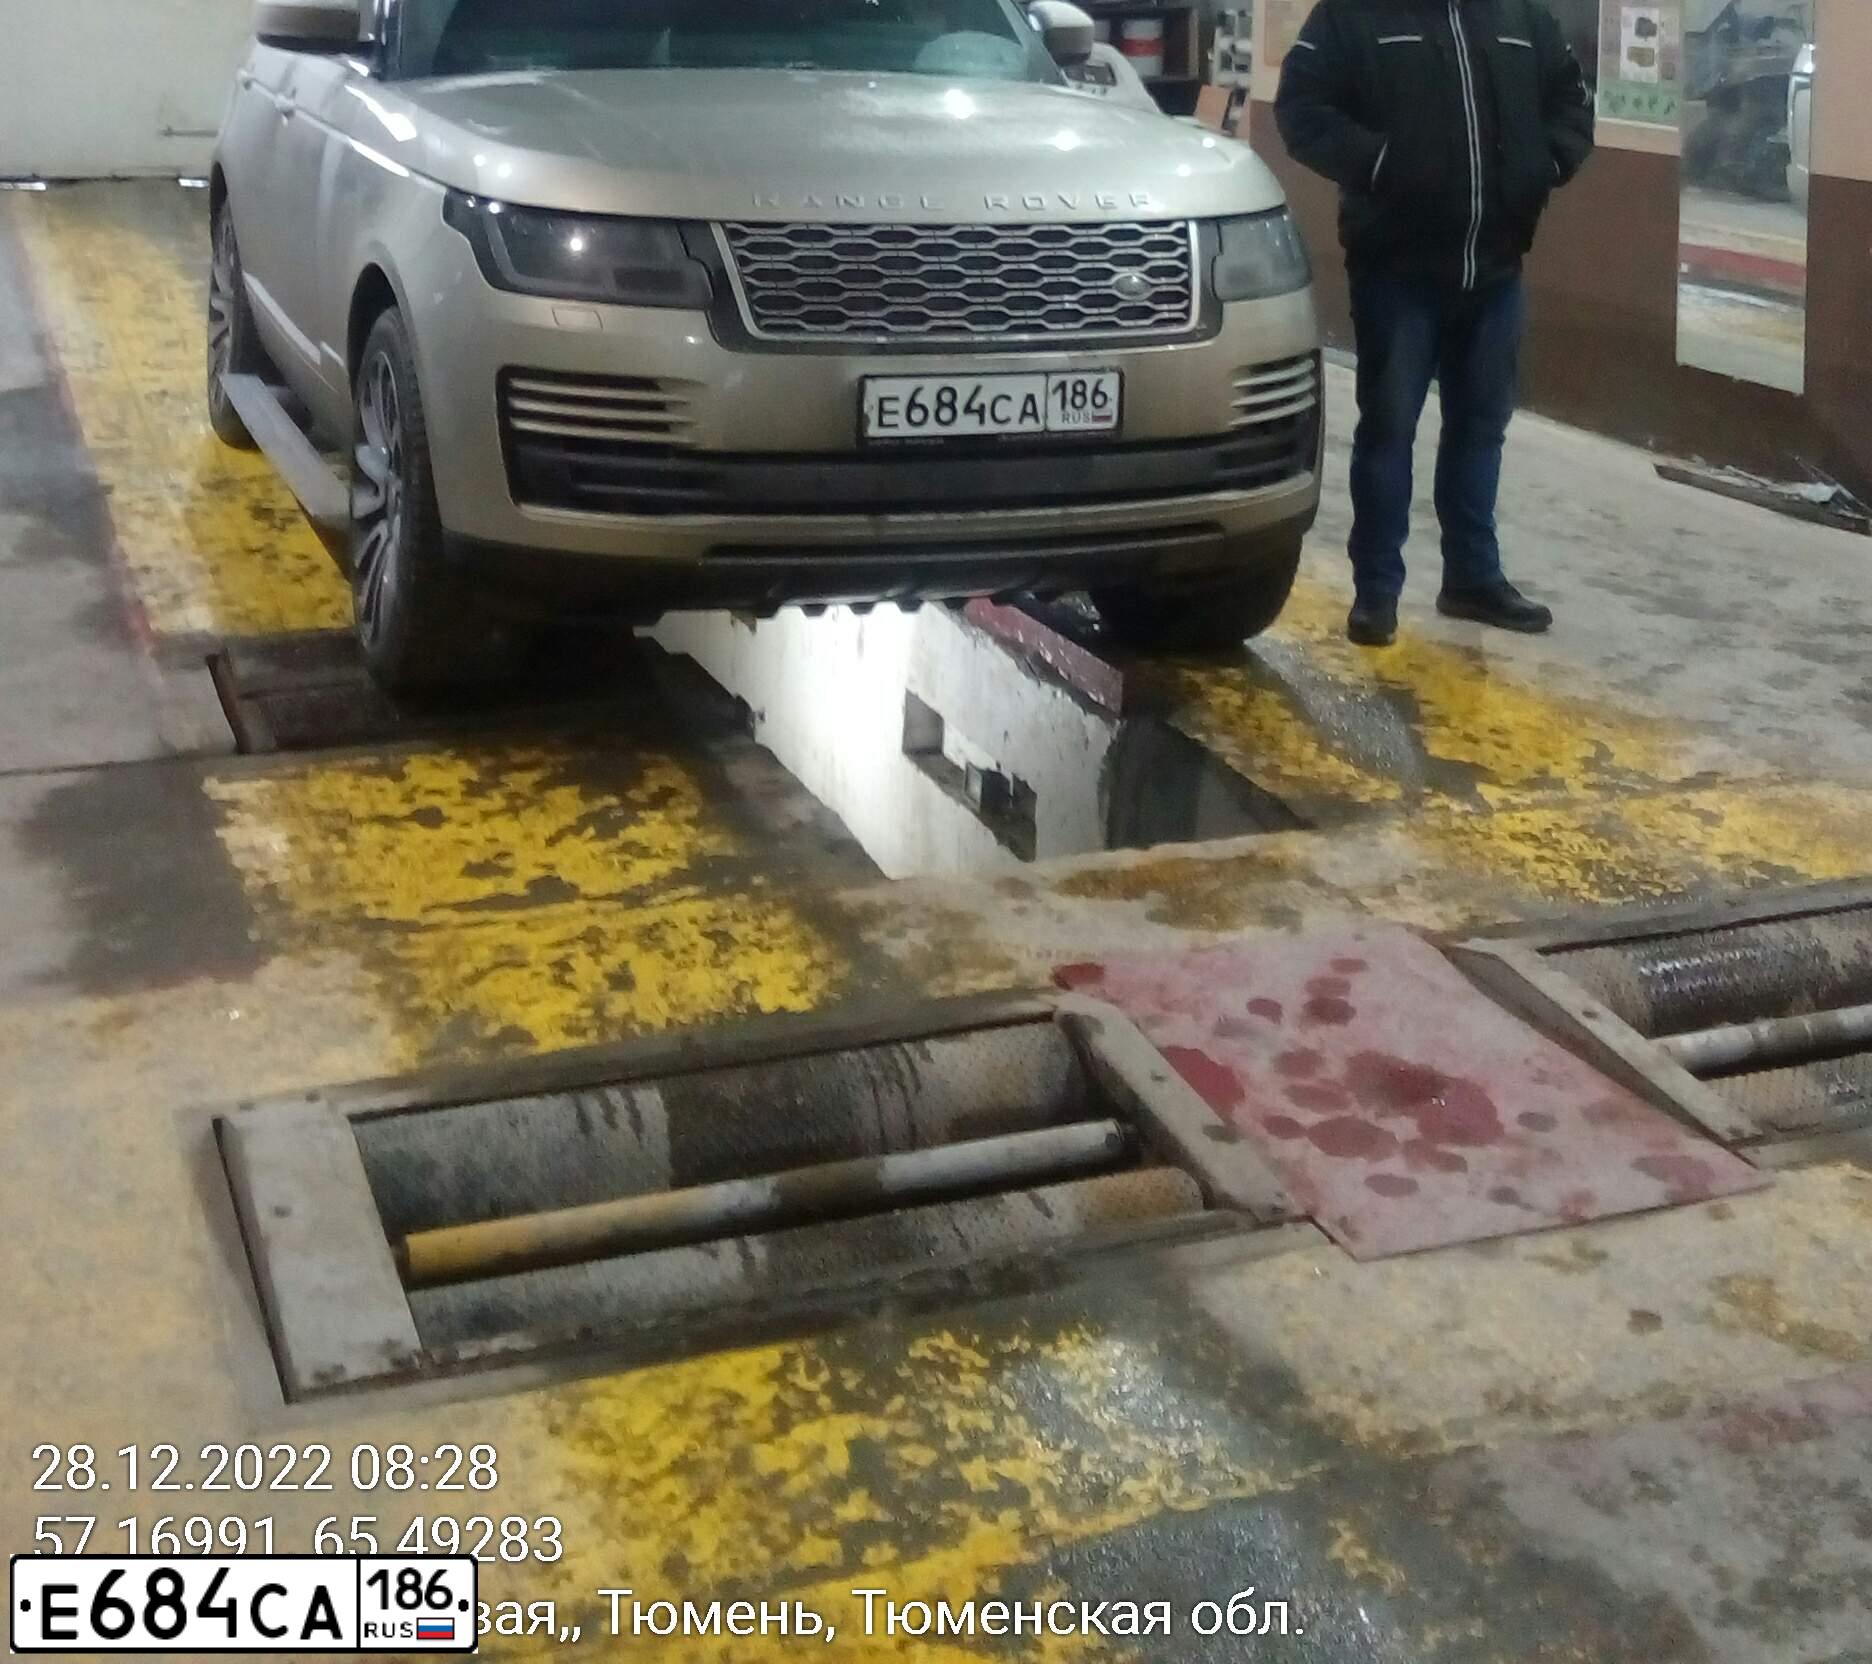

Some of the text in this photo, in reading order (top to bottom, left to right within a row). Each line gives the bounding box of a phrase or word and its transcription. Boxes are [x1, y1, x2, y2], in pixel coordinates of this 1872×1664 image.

[982, 191, 1151, 212] ROVER
[1051, 378, 1108, 411] 186
[1061, 411, 1091, 424] RUS
